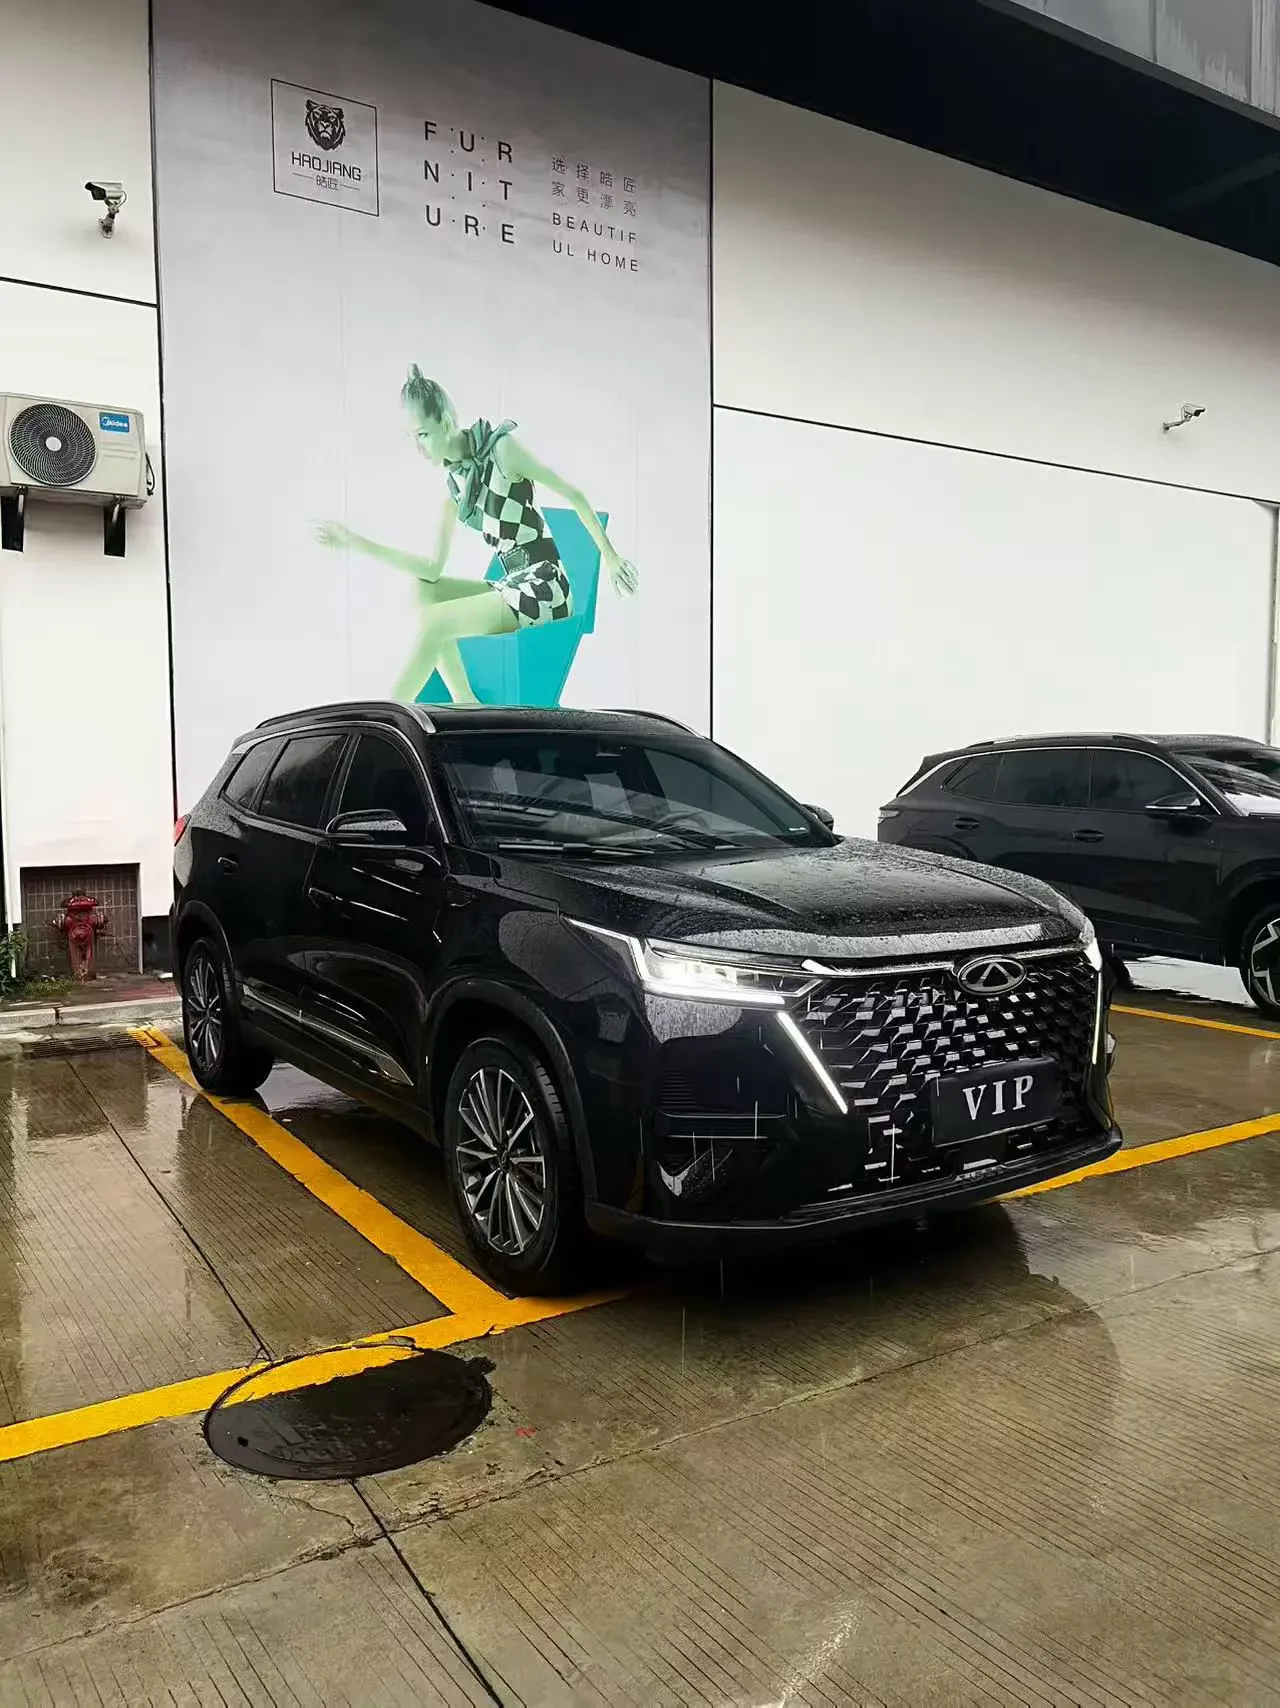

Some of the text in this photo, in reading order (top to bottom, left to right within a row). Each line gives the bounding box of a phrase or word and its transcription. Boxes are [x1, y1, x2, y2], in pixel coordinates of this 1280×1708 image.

[291, 151, 361, 181] HAOJIANG
[551, 180, 637, 217] 家更漂亮
[552, 212, 637, 244] BEAUTIF
[552, 239, 639, 272] UL HOME
[101, 416, 128, 428] Midea
[962, 1074, 1034, 1121] VIP
